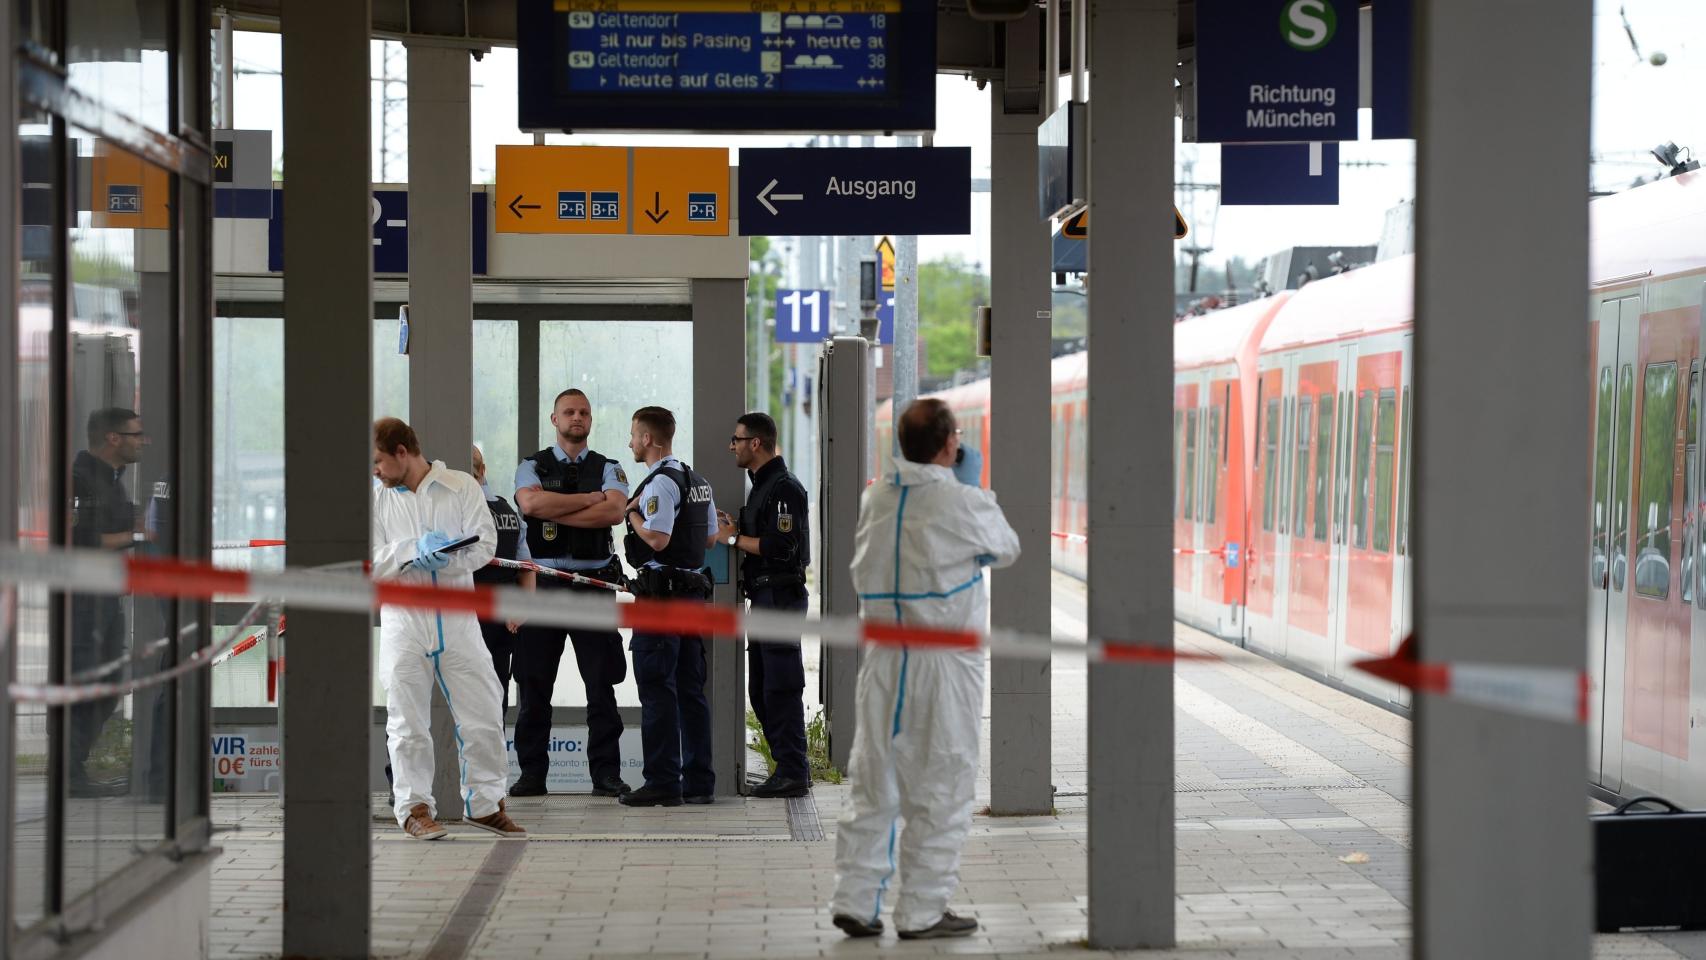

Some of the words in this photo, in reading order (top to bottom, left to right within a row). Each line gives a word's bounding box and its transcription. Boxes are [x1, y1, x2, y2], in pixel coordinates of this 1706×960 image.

[598, 13, 679, 28] Geltendorf
[869, 14, 886, 29] 18
[626, 35, 655, 48] nur
[661, 34, 687, 48] bis
[693, 34, 751, 51] Pasing
[807, 34, 861, 48] heute
[598, 53, 679, 67] Geltendorf
[867, 54, 886, 69] 38
[618, 73, 673, 87] heute
[680, 73, 708, 88] auf
[714, 73, 758, 88] Gleis
[764, 74, 774, 88] 2
[1250, 85, 1336, 106] Richtung
[1246, 109, 1336, 128] München
[213, 155, 228, 168] XI
[825, 176, 916, 200] Ausgang
[559, 203, 585, 216] P+R
[592, 203, 618, 216] B+R
[689, 204, 715, 217] P+R
[782, 290, 821, 333] 11
[492, 512, 519, 530] LIZEI
[547, 736, 582, 752] iro:
[249, 757, 272, 767] fürs
[549, 758, 580, 768] okonto
